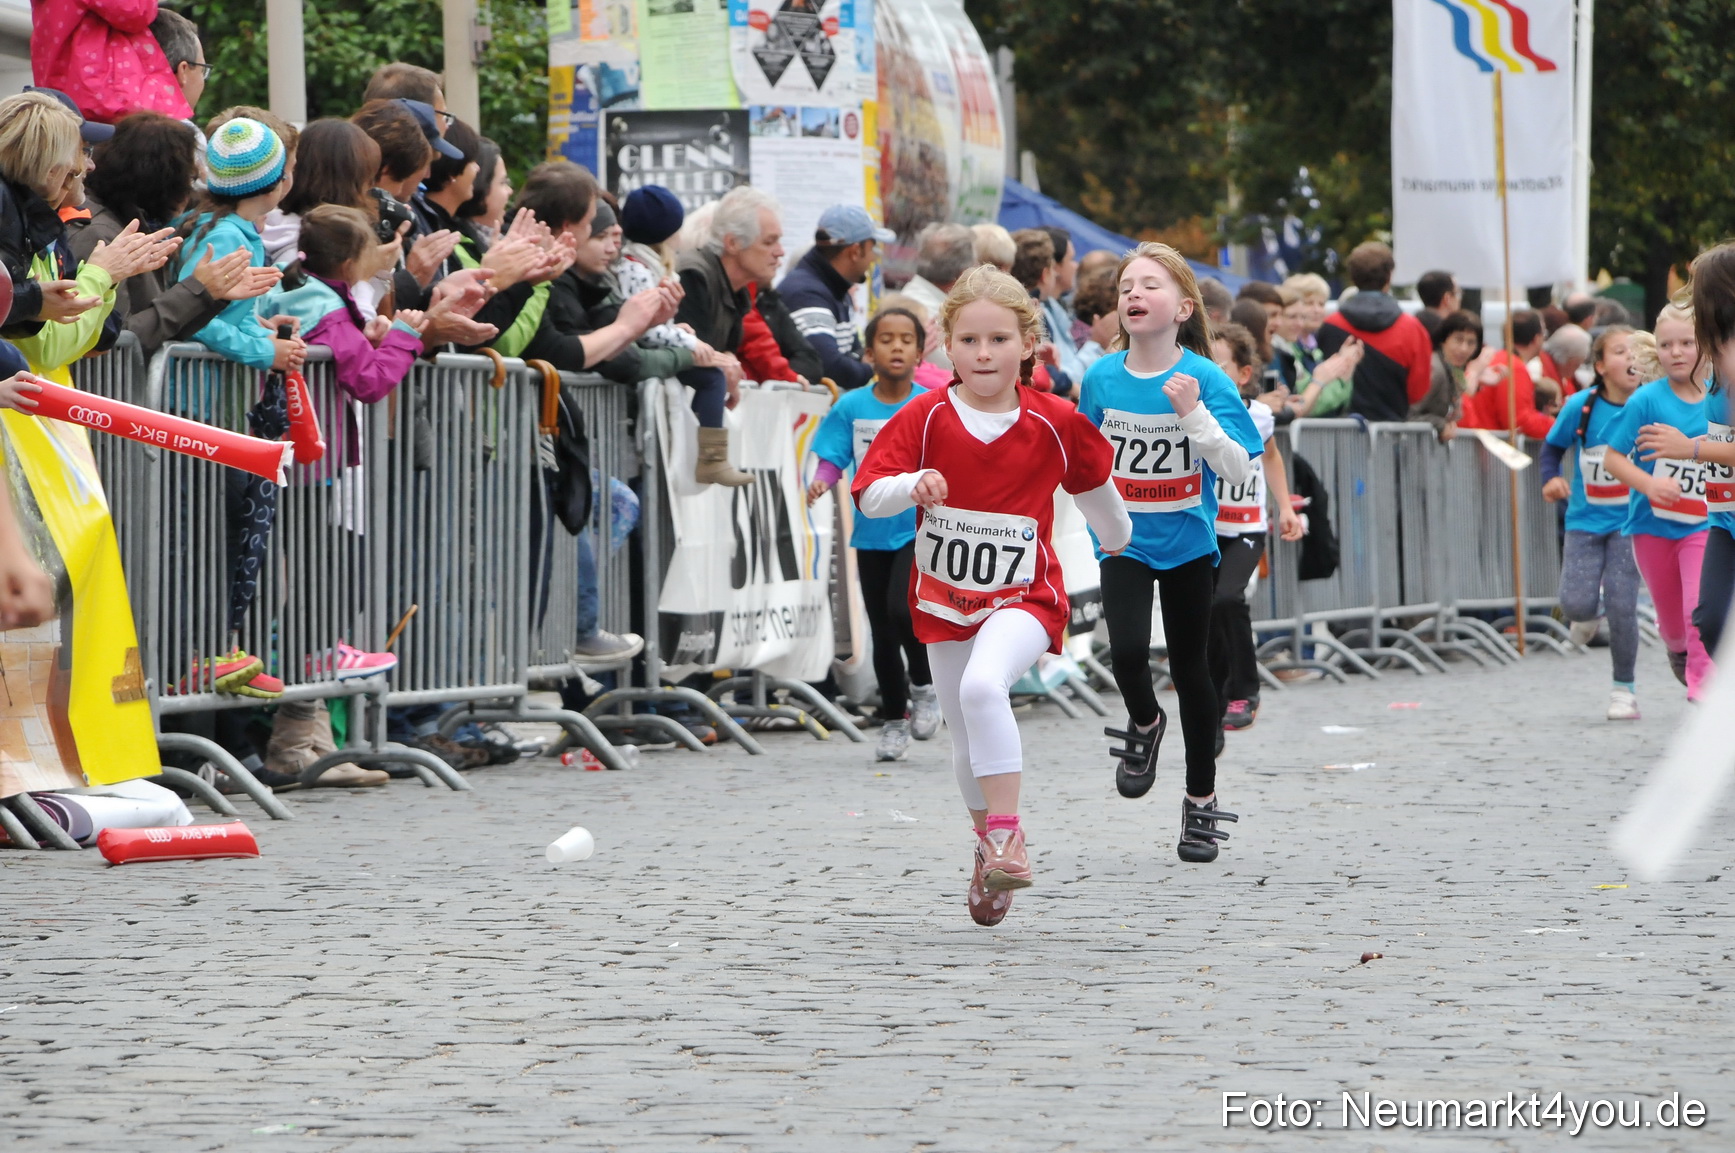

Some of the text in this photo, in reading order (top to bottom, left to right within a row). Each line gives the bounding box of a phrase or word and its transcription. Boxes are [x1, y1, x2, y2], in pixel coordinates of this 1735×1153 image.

[617, 143, 735, 173] GLENN
[129, 421, 219, 457] Audi BKK
[1134, 422, 1185, 434] Neumark
[1110, 434, 1191, 475] 7221
[1125, 482, 1177, 499] Carolin
[925, 510, 1018, 539] PARTL Neumarkt
[925, 530, 1026, 586] 7007
[947, 590, 988, 612] Katrin
